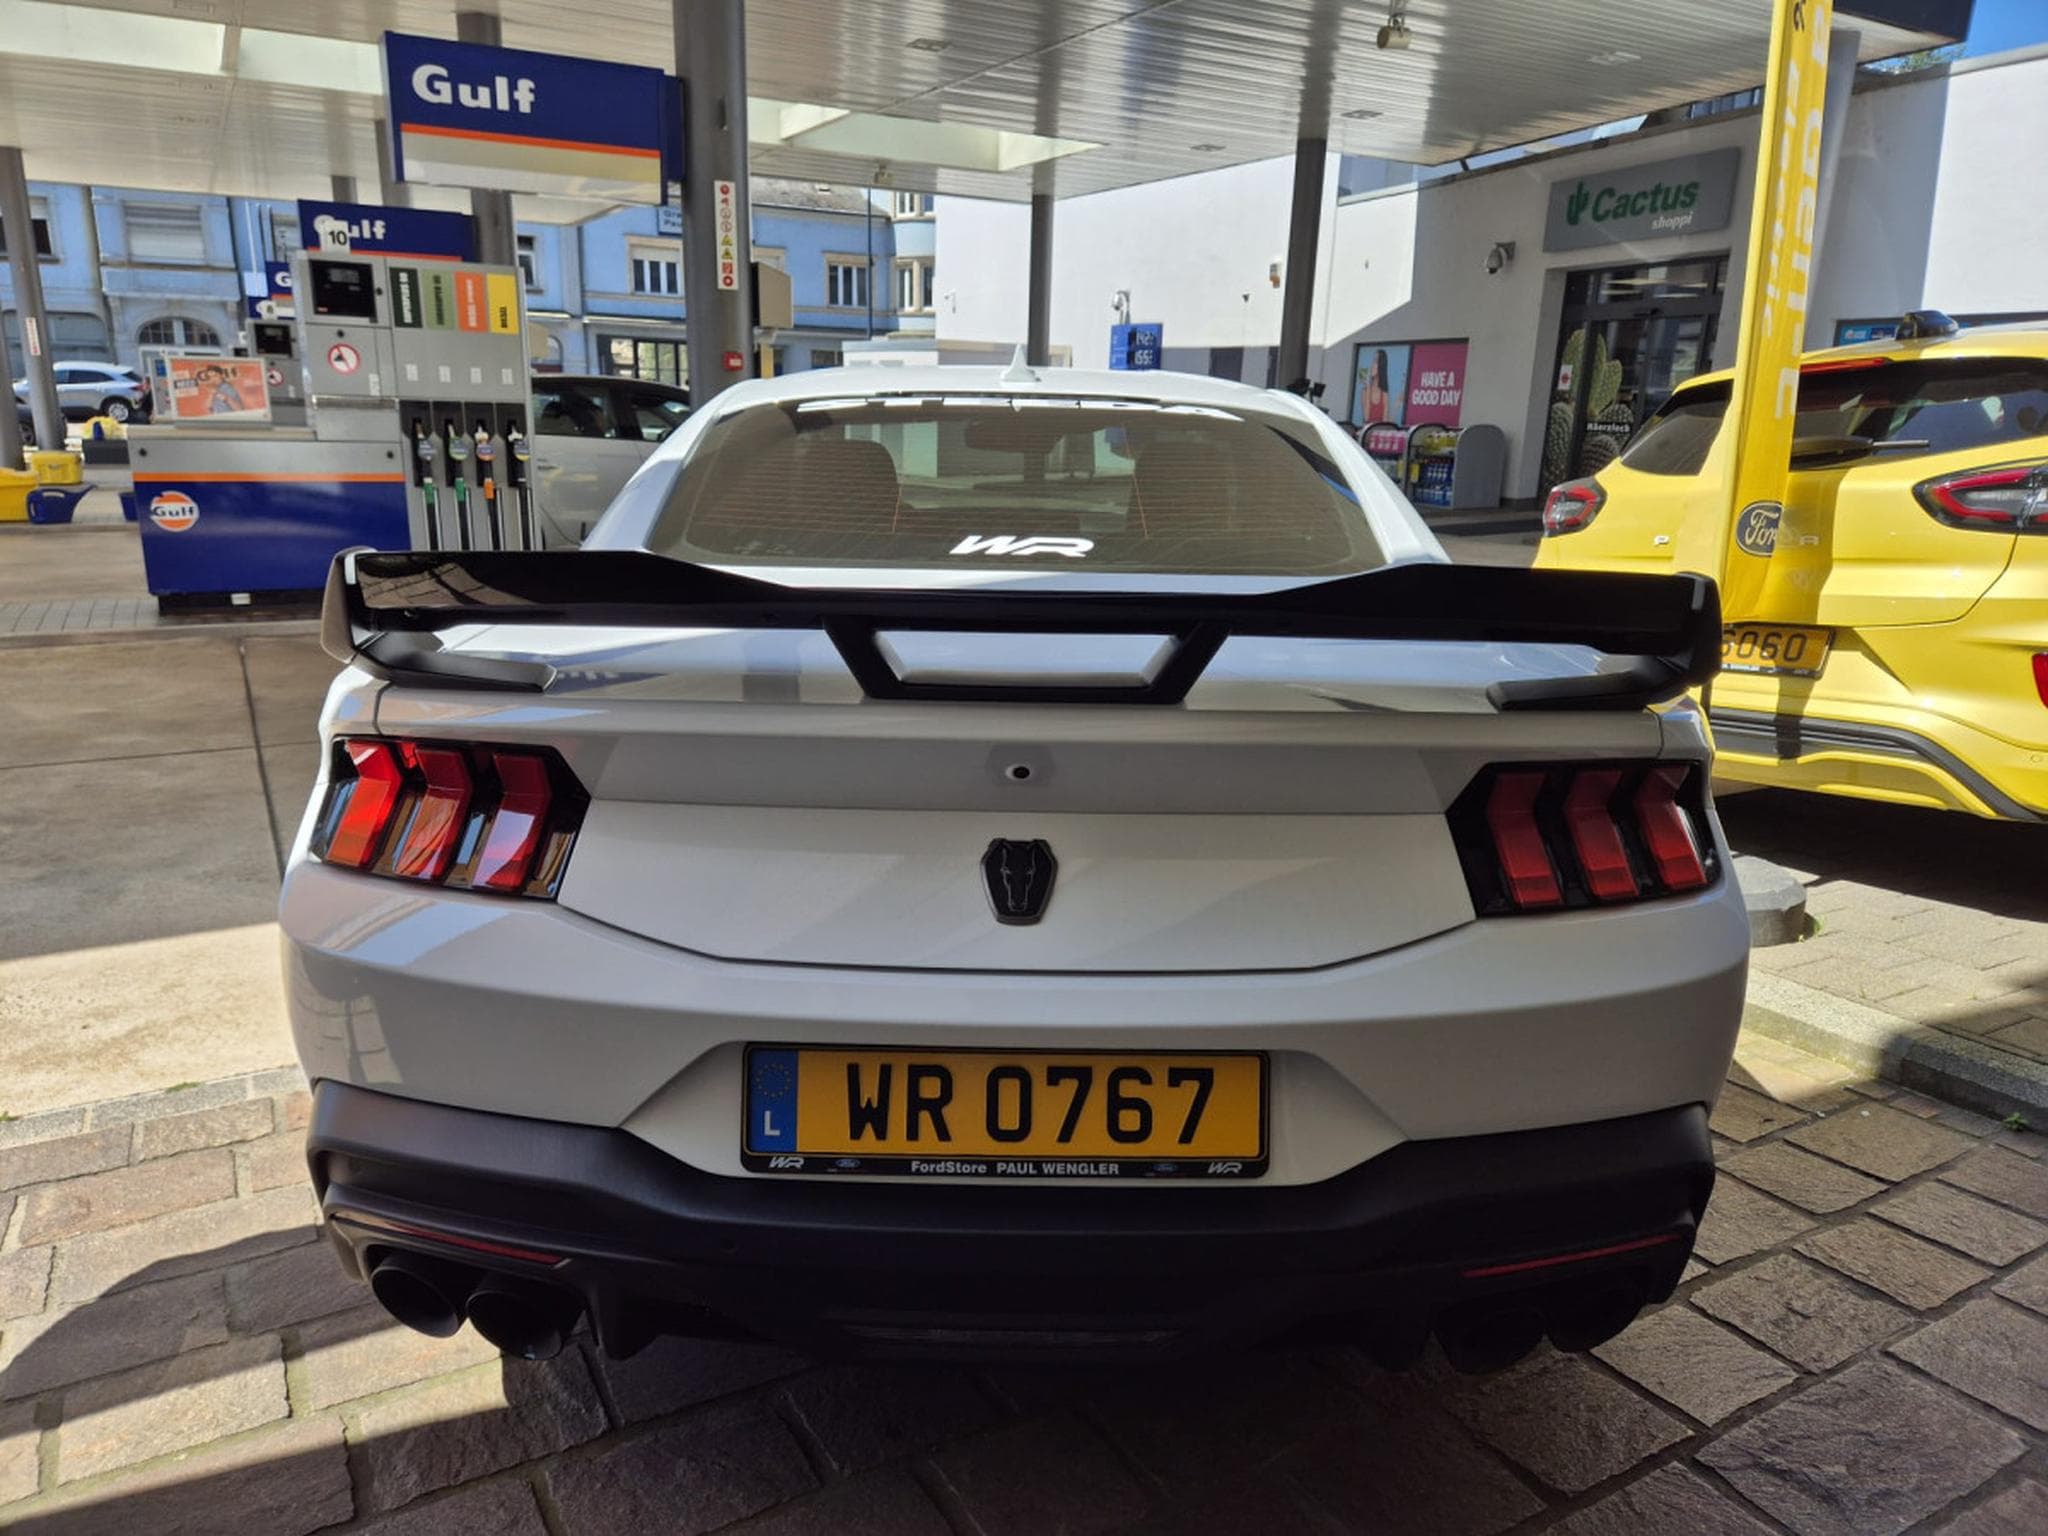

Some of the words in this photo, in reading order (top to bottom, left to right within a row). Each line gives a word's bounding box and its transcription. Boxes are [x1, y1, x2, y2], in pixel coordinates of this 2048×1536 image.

[411, 63, 537, 114] Gulf
[1591, 180, 1701, 222] Cactus
[1651, 211, 1694, 231] shoppi
[329, 230, 348, 246] 10
[1420, 371, 1447, 388] HAVE
[1447, 370, 1456, 387] A
[1411, 389, 1440, 406] GOOD
[1440, 389, 1462, 406] DAY
[152, 505, 196, 519] Gulf
[1745, 509, 1778, 546] For
[949, 535, 1095, 558] WR
[846, 1063, 953, 1142] WR
[985, 1065, 1215, 1145] 0767
[763, 1110, 781, 1137] L
[768, 1156, 805, 1170] WR
[911, 1160, 988, 1174] FordStore
[996, 1162, 1038, 1175] PAUL
[1041, 1162, 1120, 1175] WENGLER
[1207, 1161, 1244, 1175] WR
